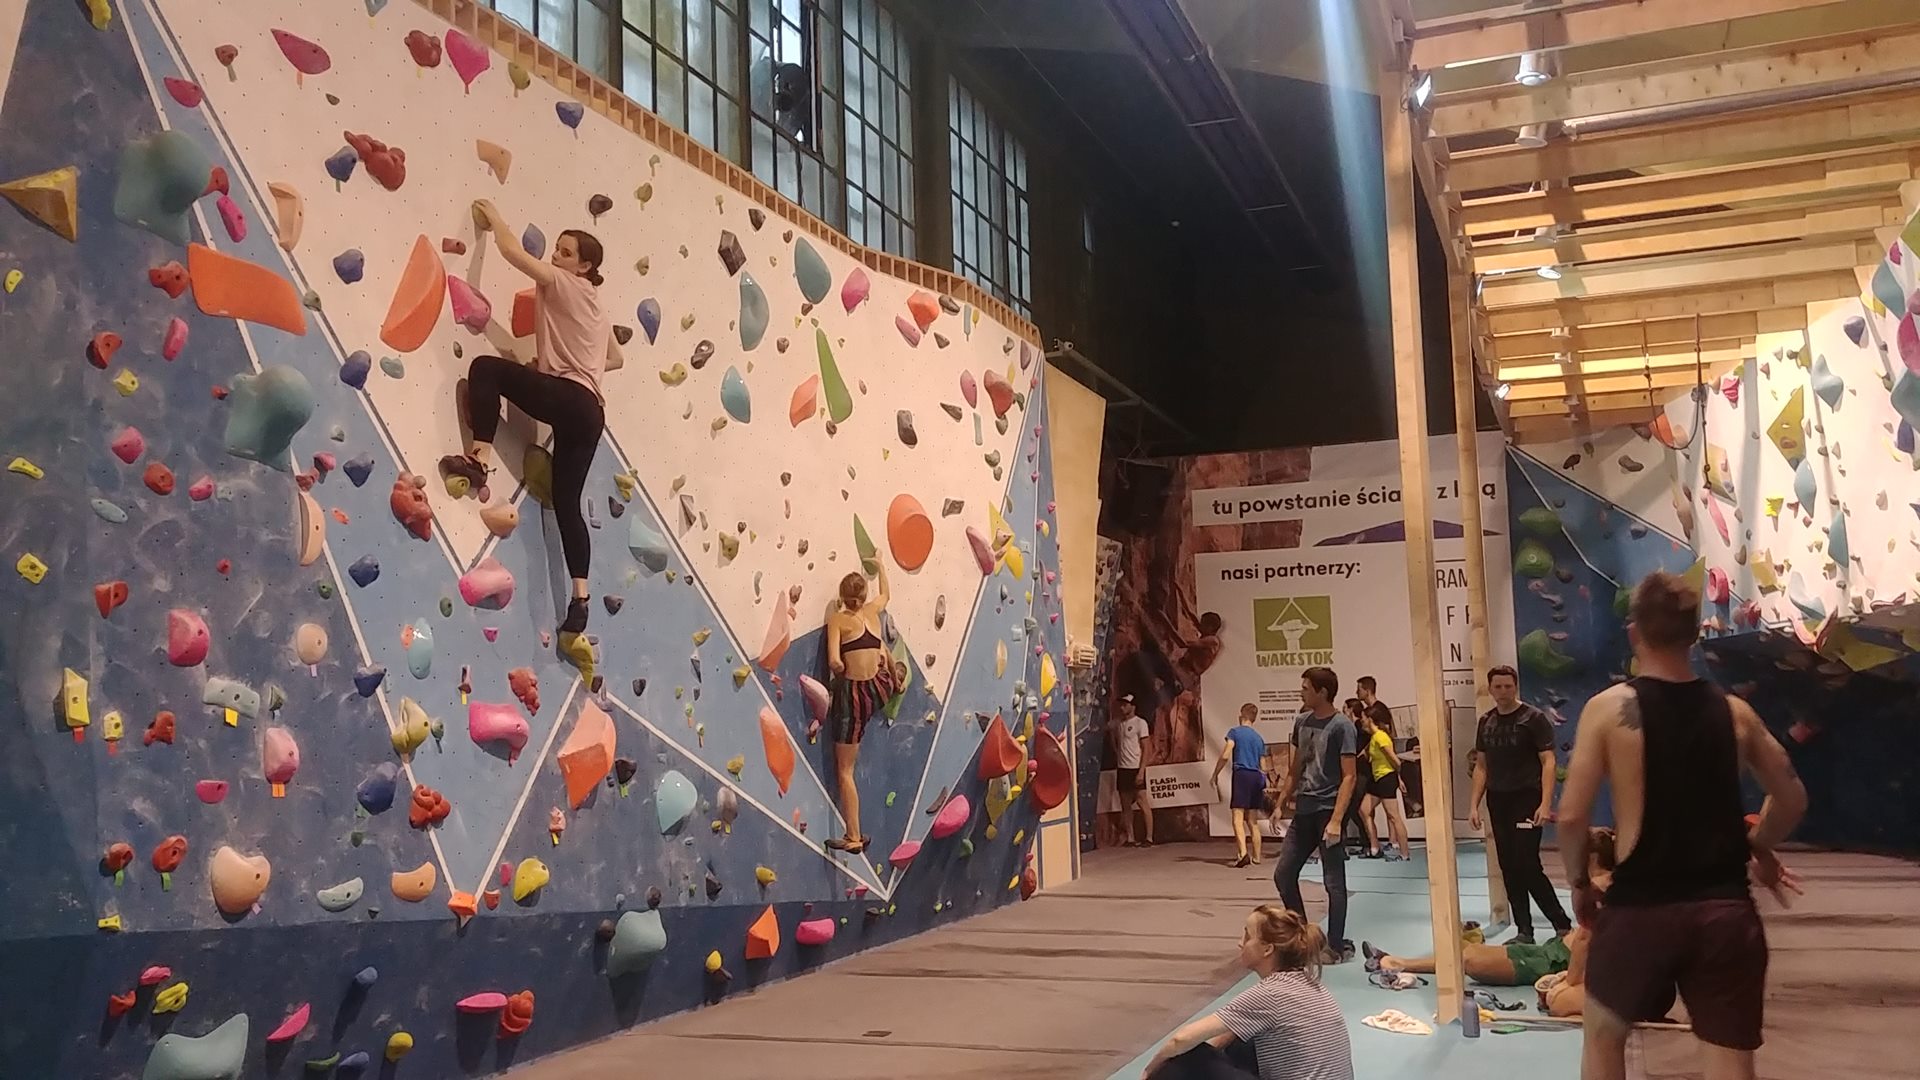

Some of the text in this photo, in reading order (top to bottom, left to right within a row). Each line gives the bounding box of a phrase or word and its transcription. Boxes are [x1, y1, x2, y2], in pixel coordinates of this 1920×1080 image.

[1212, 499, 1233, 515] tu
[1239, 490, 1351, 518] powstanie
[1356, 485, 1403, 505] ścia
[1436, 486, 1448, 500] z
[1221, 561, 1361, 583] nasi partnerzy:
[1256, 651, 1334, 667] WAKESTOK
[1150, 777, 1176, 785] FLASH
[1150, 782, 1200, 792] EXPEDITION
[1151, 791, 1175, 799] TEAM
